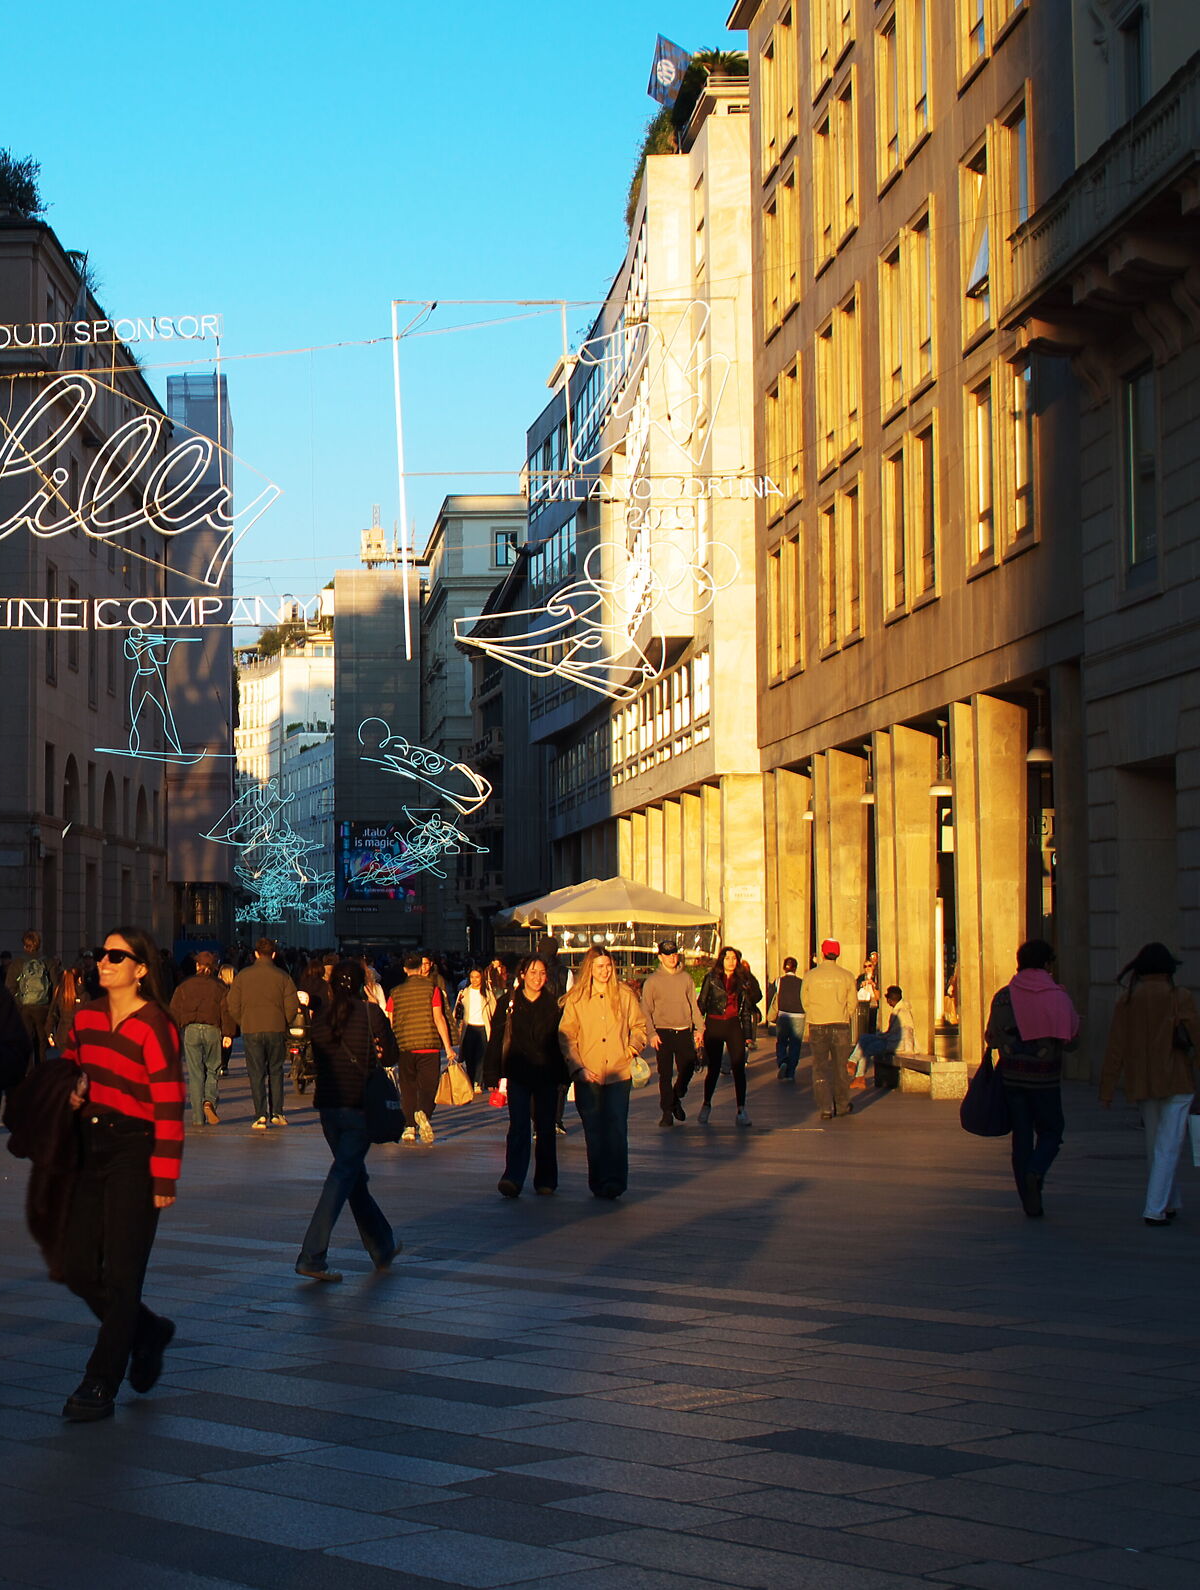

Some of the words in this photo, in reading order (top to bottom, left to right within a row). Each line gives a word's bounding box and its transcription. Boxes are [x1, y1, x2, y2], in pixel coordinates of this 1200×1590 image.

[74, 315, 218, 345] SPONSOR
[531, 477, 652, 500] MILANO
[662, 475, 785, 499] CORTINA
[96, 596, 321, 629] COMPANY
[354, 837, 363, 847] is
[365, 836, 395, 848] magic
